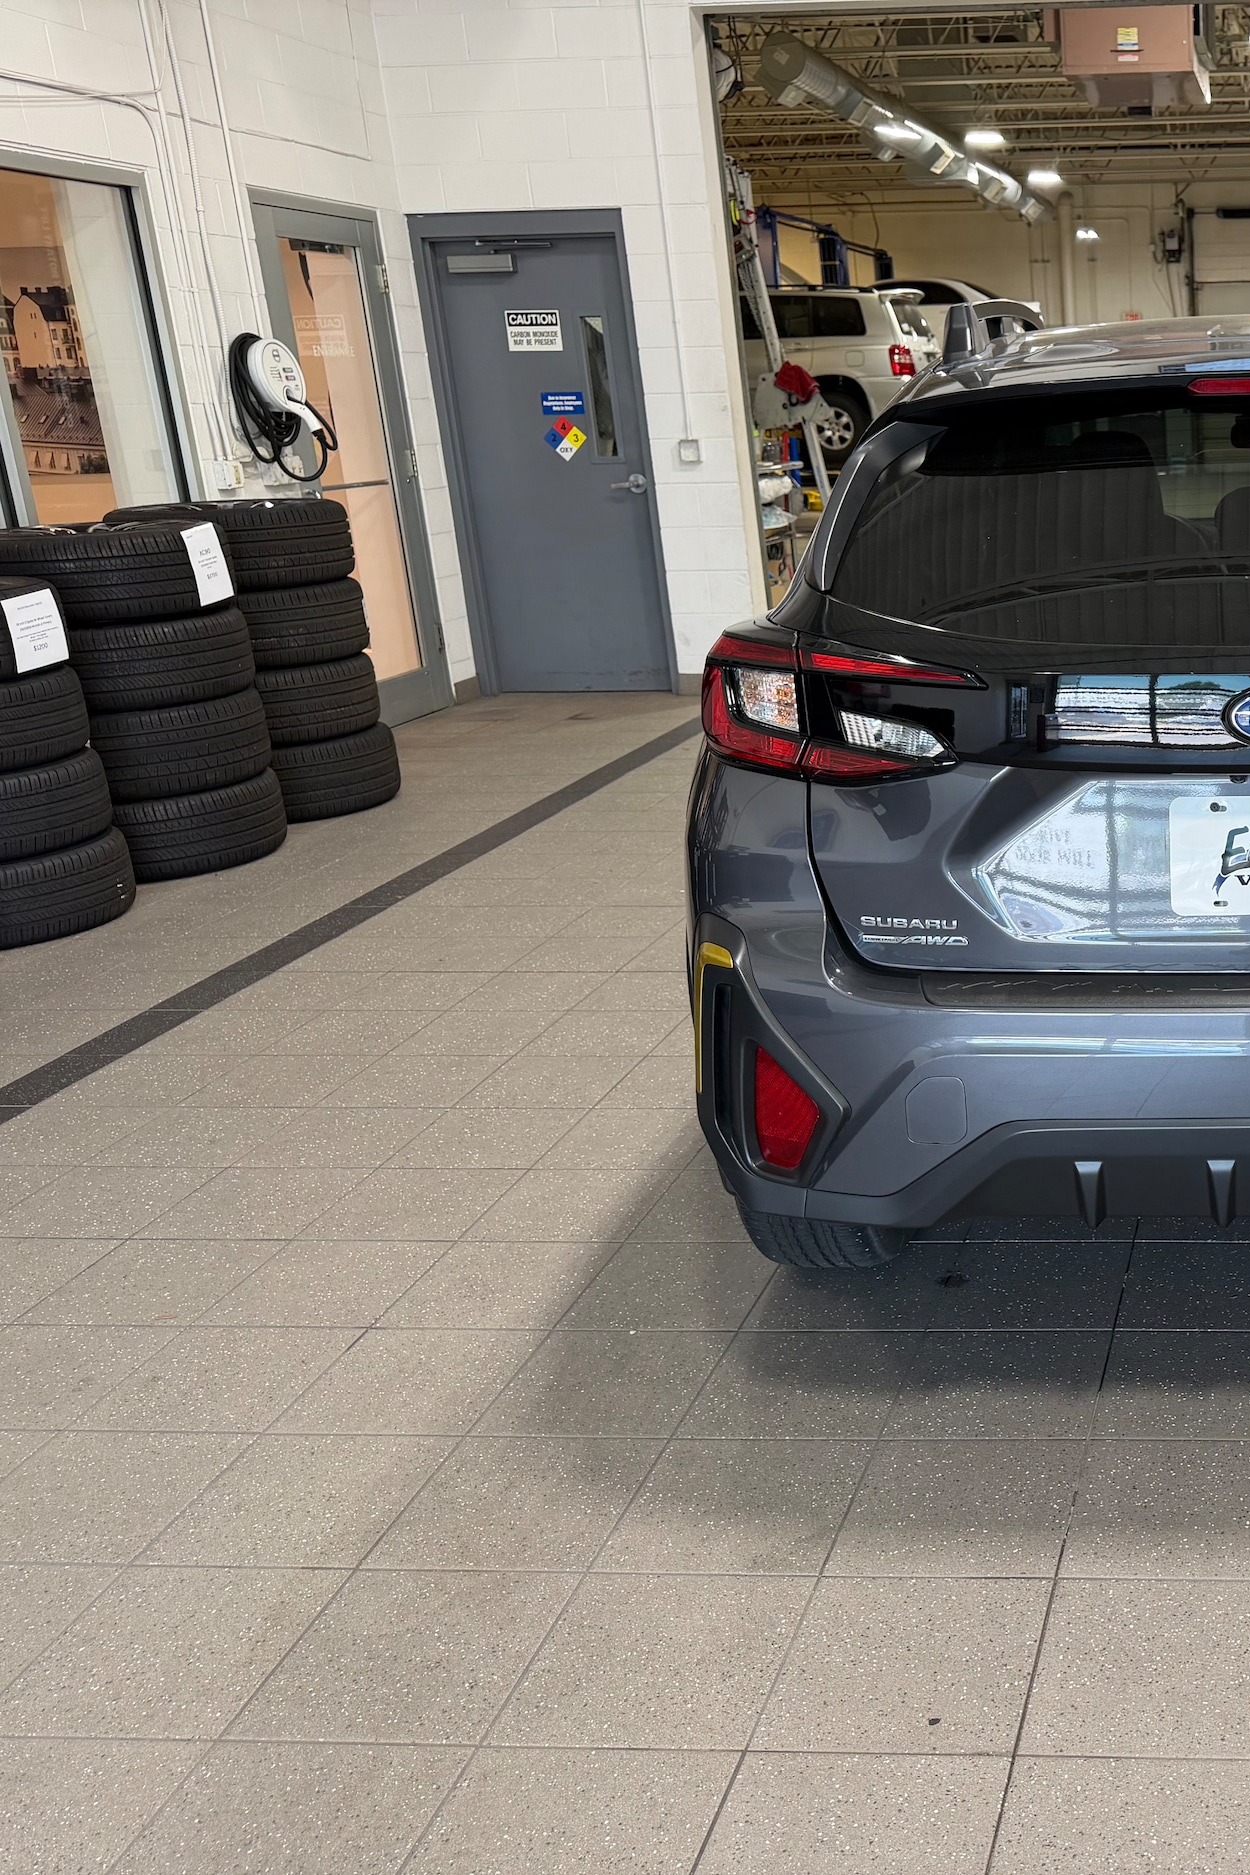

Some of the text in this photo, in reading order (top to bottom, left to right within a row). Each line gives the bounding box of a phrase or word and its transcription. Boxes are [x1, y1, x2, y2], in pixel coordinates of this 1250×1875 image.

[508, 314, 556, 325] CAUTION
[312, 345, 356, 357] ENTRANCE
[560, 422, 567, 431] 4
[551, 433, 580, 443] 2 3
[860, 915, 958, 930] SUBARU
[902, 935, 969, 946] AWD
